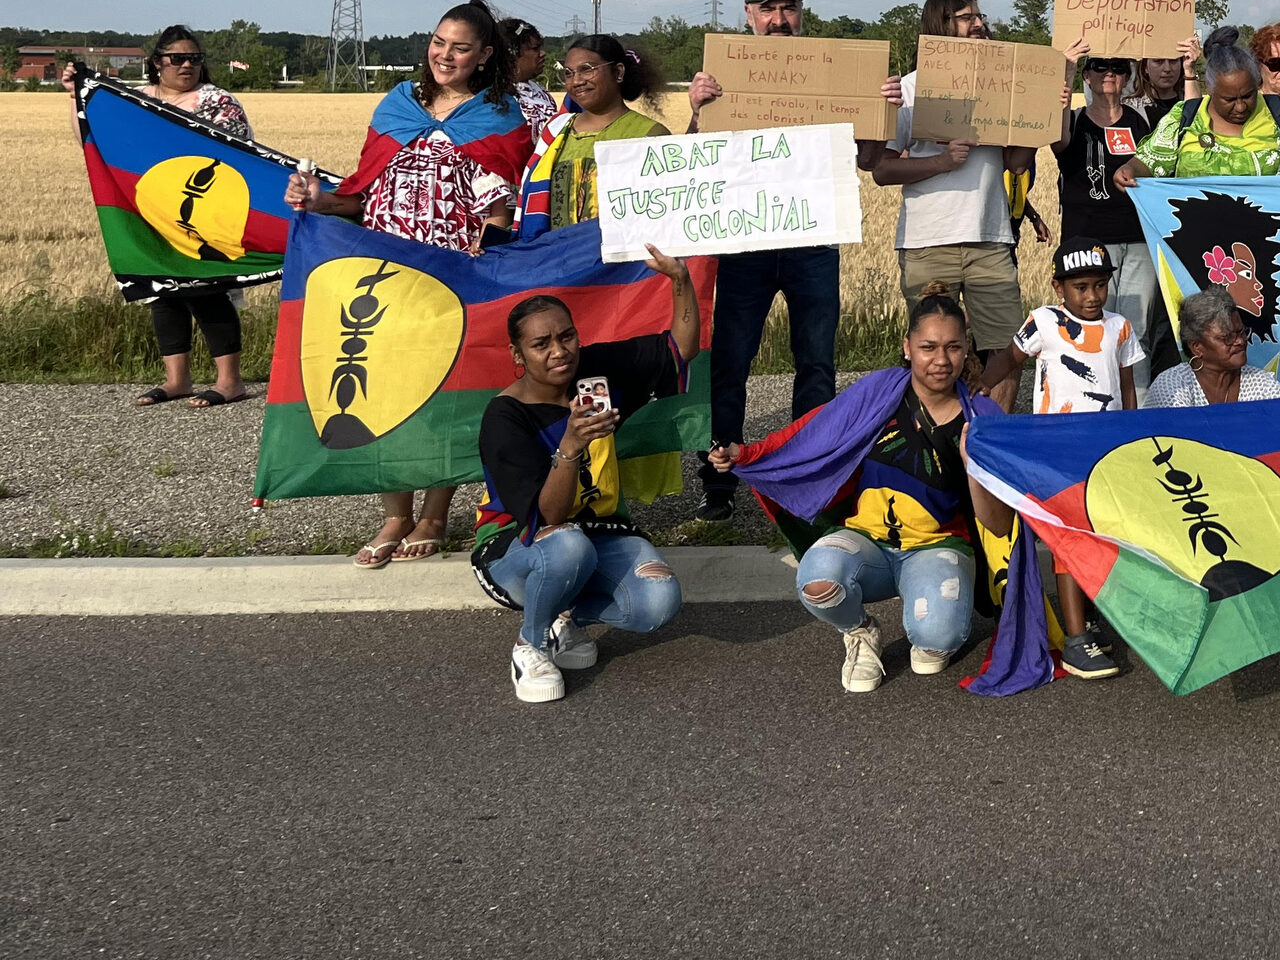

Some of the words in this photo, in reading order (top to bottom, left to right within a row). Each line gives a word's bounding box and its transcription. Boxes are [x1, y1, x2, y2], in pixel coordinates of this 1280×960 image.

[1081, 14, 1155, 39] politique
[727, 43, 778, 61] Liberté
[786, 52, 815, 65] pour
[822, 51, 834, 64] la
[748, 69, 809, 86] KANAKY
[923, 60, 951, 71] AVEC
[965, 60, 986, 71] NOS
[994, 62, 1056, 76] CAMARADES
[951, 73, 1027, 94] KANAKS
[730, 93, 739, 104] Il
[746, 96, 763, 105] est
[815, 100, 825, 112] le
[830, 103, 861, 117] temps
[939, 92, 953, 102] est
[730, 110, 749, 119] des
[757, 109, 805, 124] colonies
[640, 139, 728, 177] ABAT
[751, 132, 792, 162] LA
[1062, 250, 1103, 271] KING
